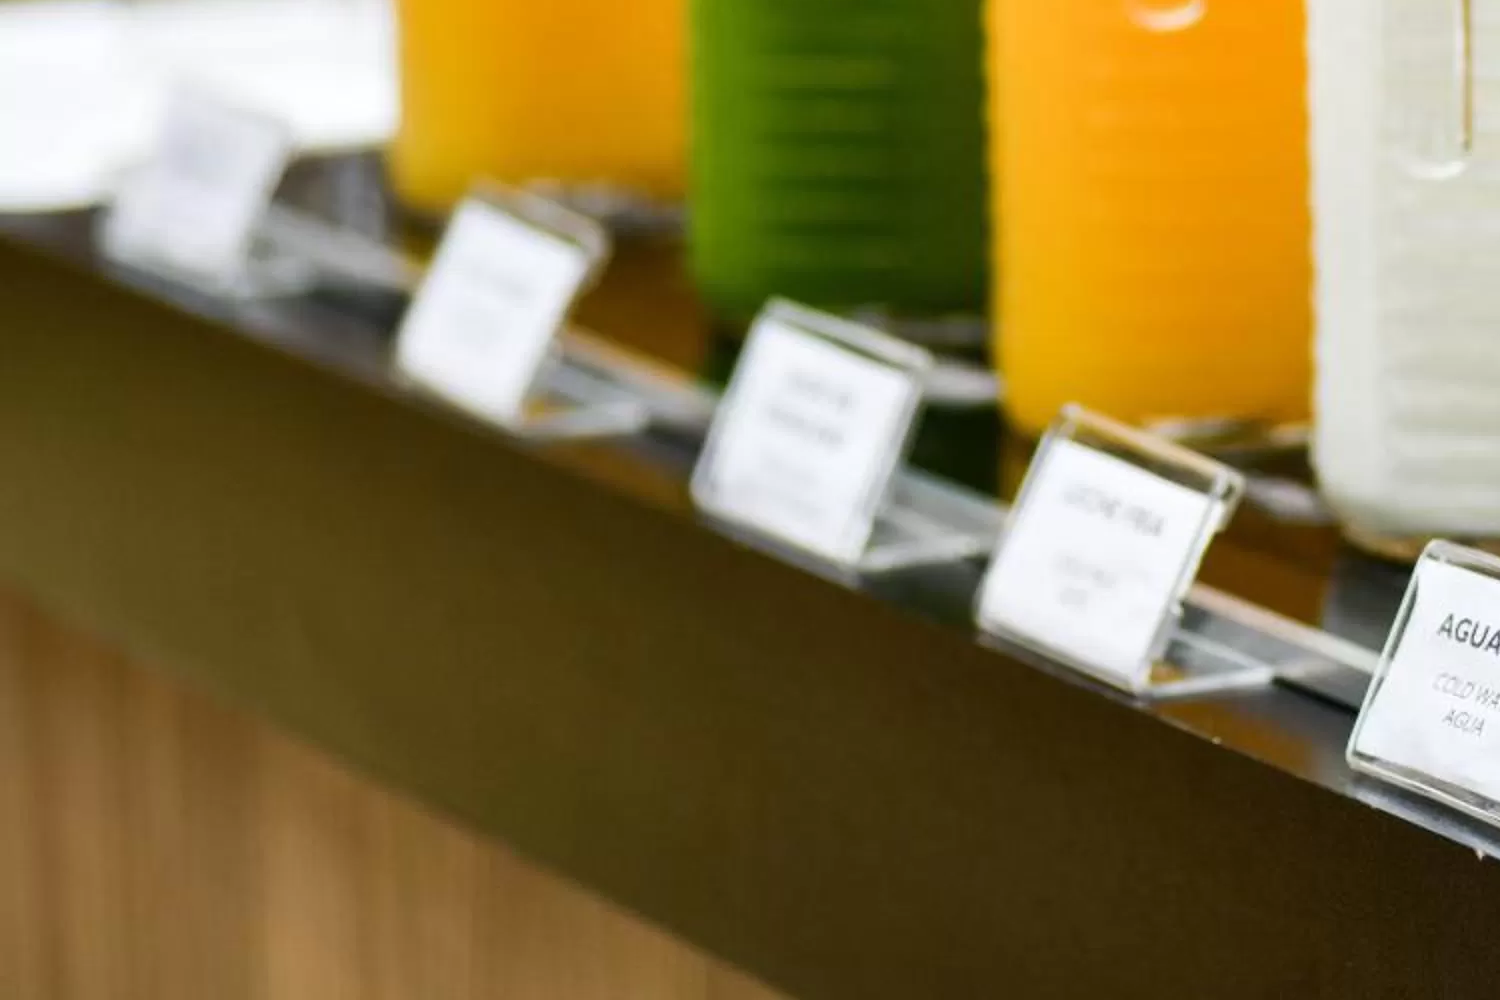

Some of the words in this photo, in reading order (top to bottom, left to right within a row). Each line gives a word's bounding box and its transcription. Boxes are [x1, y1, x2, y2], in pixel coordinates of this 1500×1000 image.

[1436, 613, 1500, 658] AGUA
[1431, 671, 1475, 701] COLD
[1441, 709, 1486, 737] AGUA
